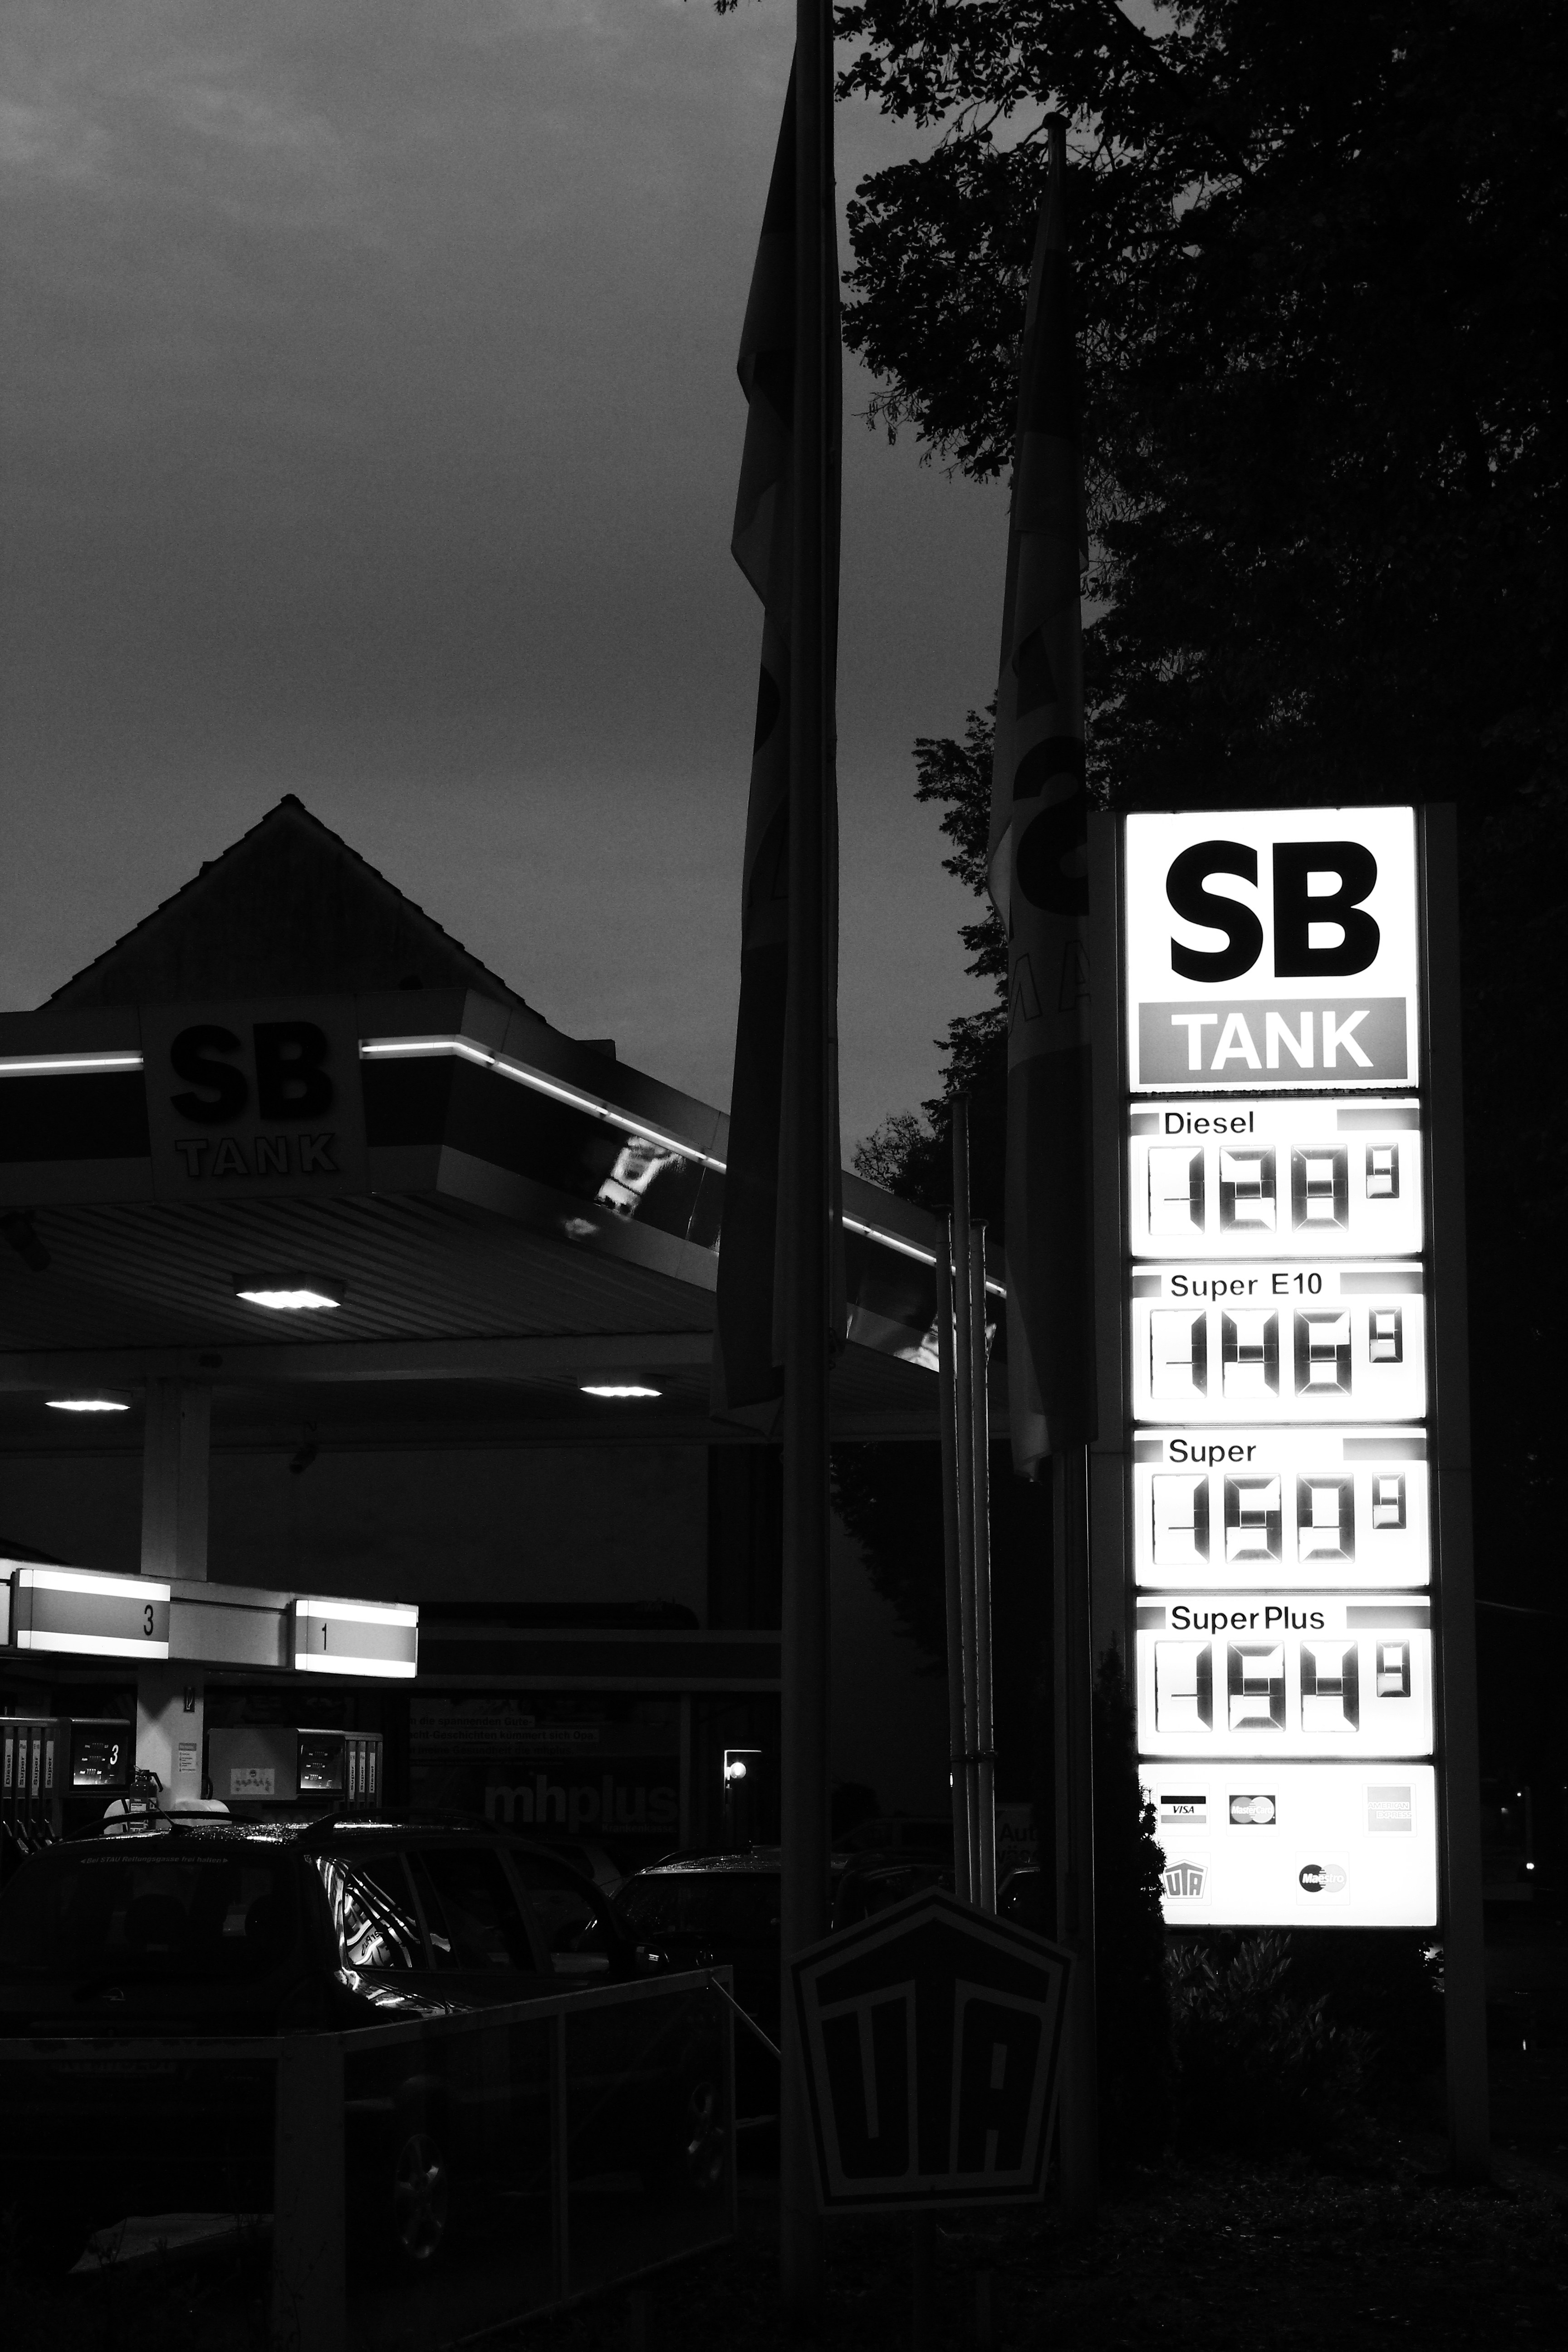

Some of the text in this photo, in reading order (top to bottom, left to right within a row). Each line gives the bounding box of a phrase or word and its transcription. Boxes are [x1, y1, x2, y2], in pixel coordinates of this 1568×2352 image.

[1166, 840, 1380, 983] SB
[1171, 1010, 1374, 1070] TANK
[170, 1021, 332, 1123] SB
[1165, 1111, 1254, 1134] Diesel
[175, 1133, 339, 1177] TANK
[1171, 1273, 1322, 1301] Super E10
[1169, 1439, 1256, 1467] Super
[143, 1605, 153, 1635] 3
[1171, 1606, 1324, 1634] Super Plus
[322, 1623, 327, 1650] 1
[409, 1730, 497, 1740] acht-Geschichten
[500, 1730, 546, 1740] kümmert
[549, 1730, 570, 1740] sich
[420, 1717, 435, 1725] die
[438, 1717, 501, 1726] spannenden
[505, 1717, 533, 1726] Gute-
[109, 1744, 119, 1765] 3
[453, 1745, 512, 1754] Gesundheit
[515, 1746, 530, 1754] die
[485, 1774, 678, 1834] mhplus
[1173, 1805, 1195, 1814] VISA
[1231, 1806, 1274, 1815] MasterCard
[602, 1823, 678, 1834] Krankenkasse.
[1165, 1862, 1204, 1896] UTA
[1302, 1873, 1344, 1883] Maestro
[815, 1920, 1049, 2179] UTA
